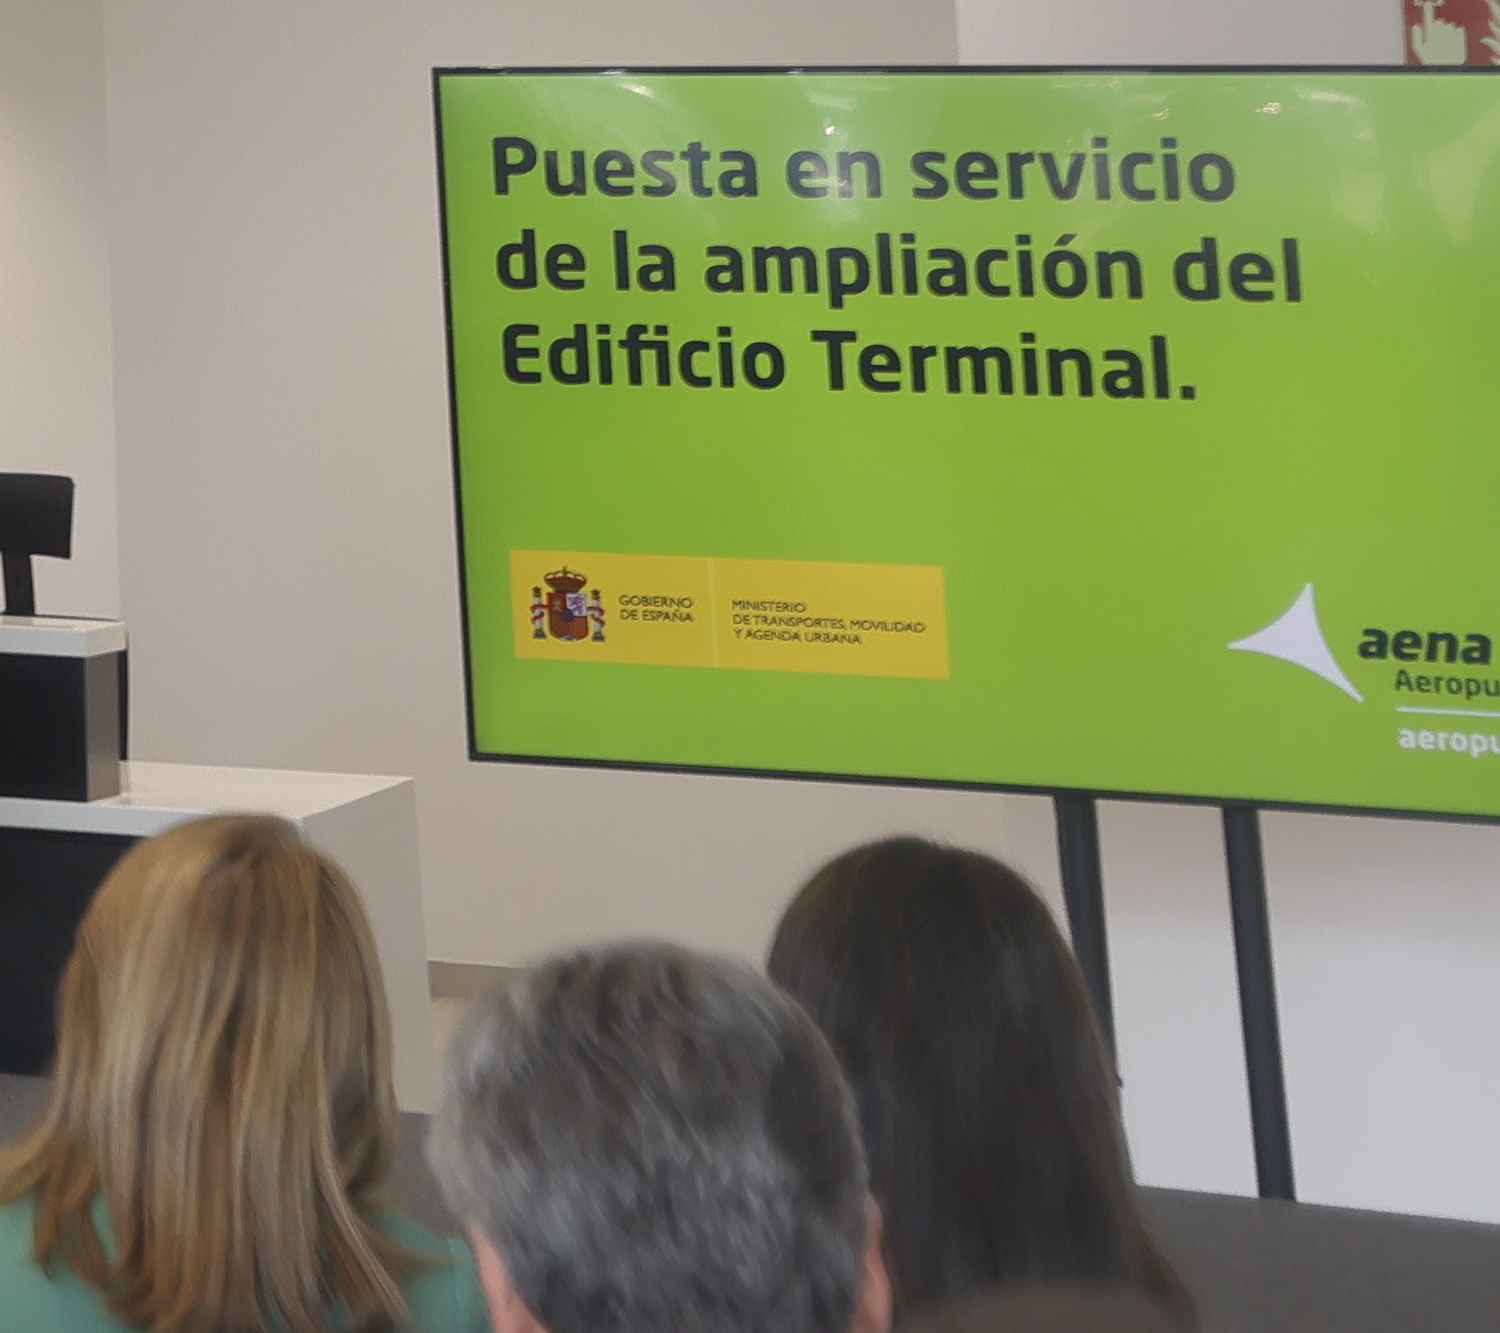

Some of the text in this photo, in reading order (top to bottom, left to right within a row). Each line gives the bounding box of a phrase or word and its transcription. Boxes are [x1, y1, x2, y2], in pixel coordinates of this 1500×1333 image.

[492, 136, 1236, 203] Puesta en servicio
[495, 228, 1302, 310] de la ampliación del
[502, 323, 1197, 401] Edificio Terminal.
[618, 594, 694, 609] GOBIERNO
[731, 600, 806, 614] MINISTERIO
[619, 609, 694, 623] DE ESPAÑA
[732, 614, 751, 626] DE
[849, 619, 927, 634] MOVILIDAD
[733, 628, 862, 645] Y AGENDA URBANA
[1357, 627, 1493, 665] aena
